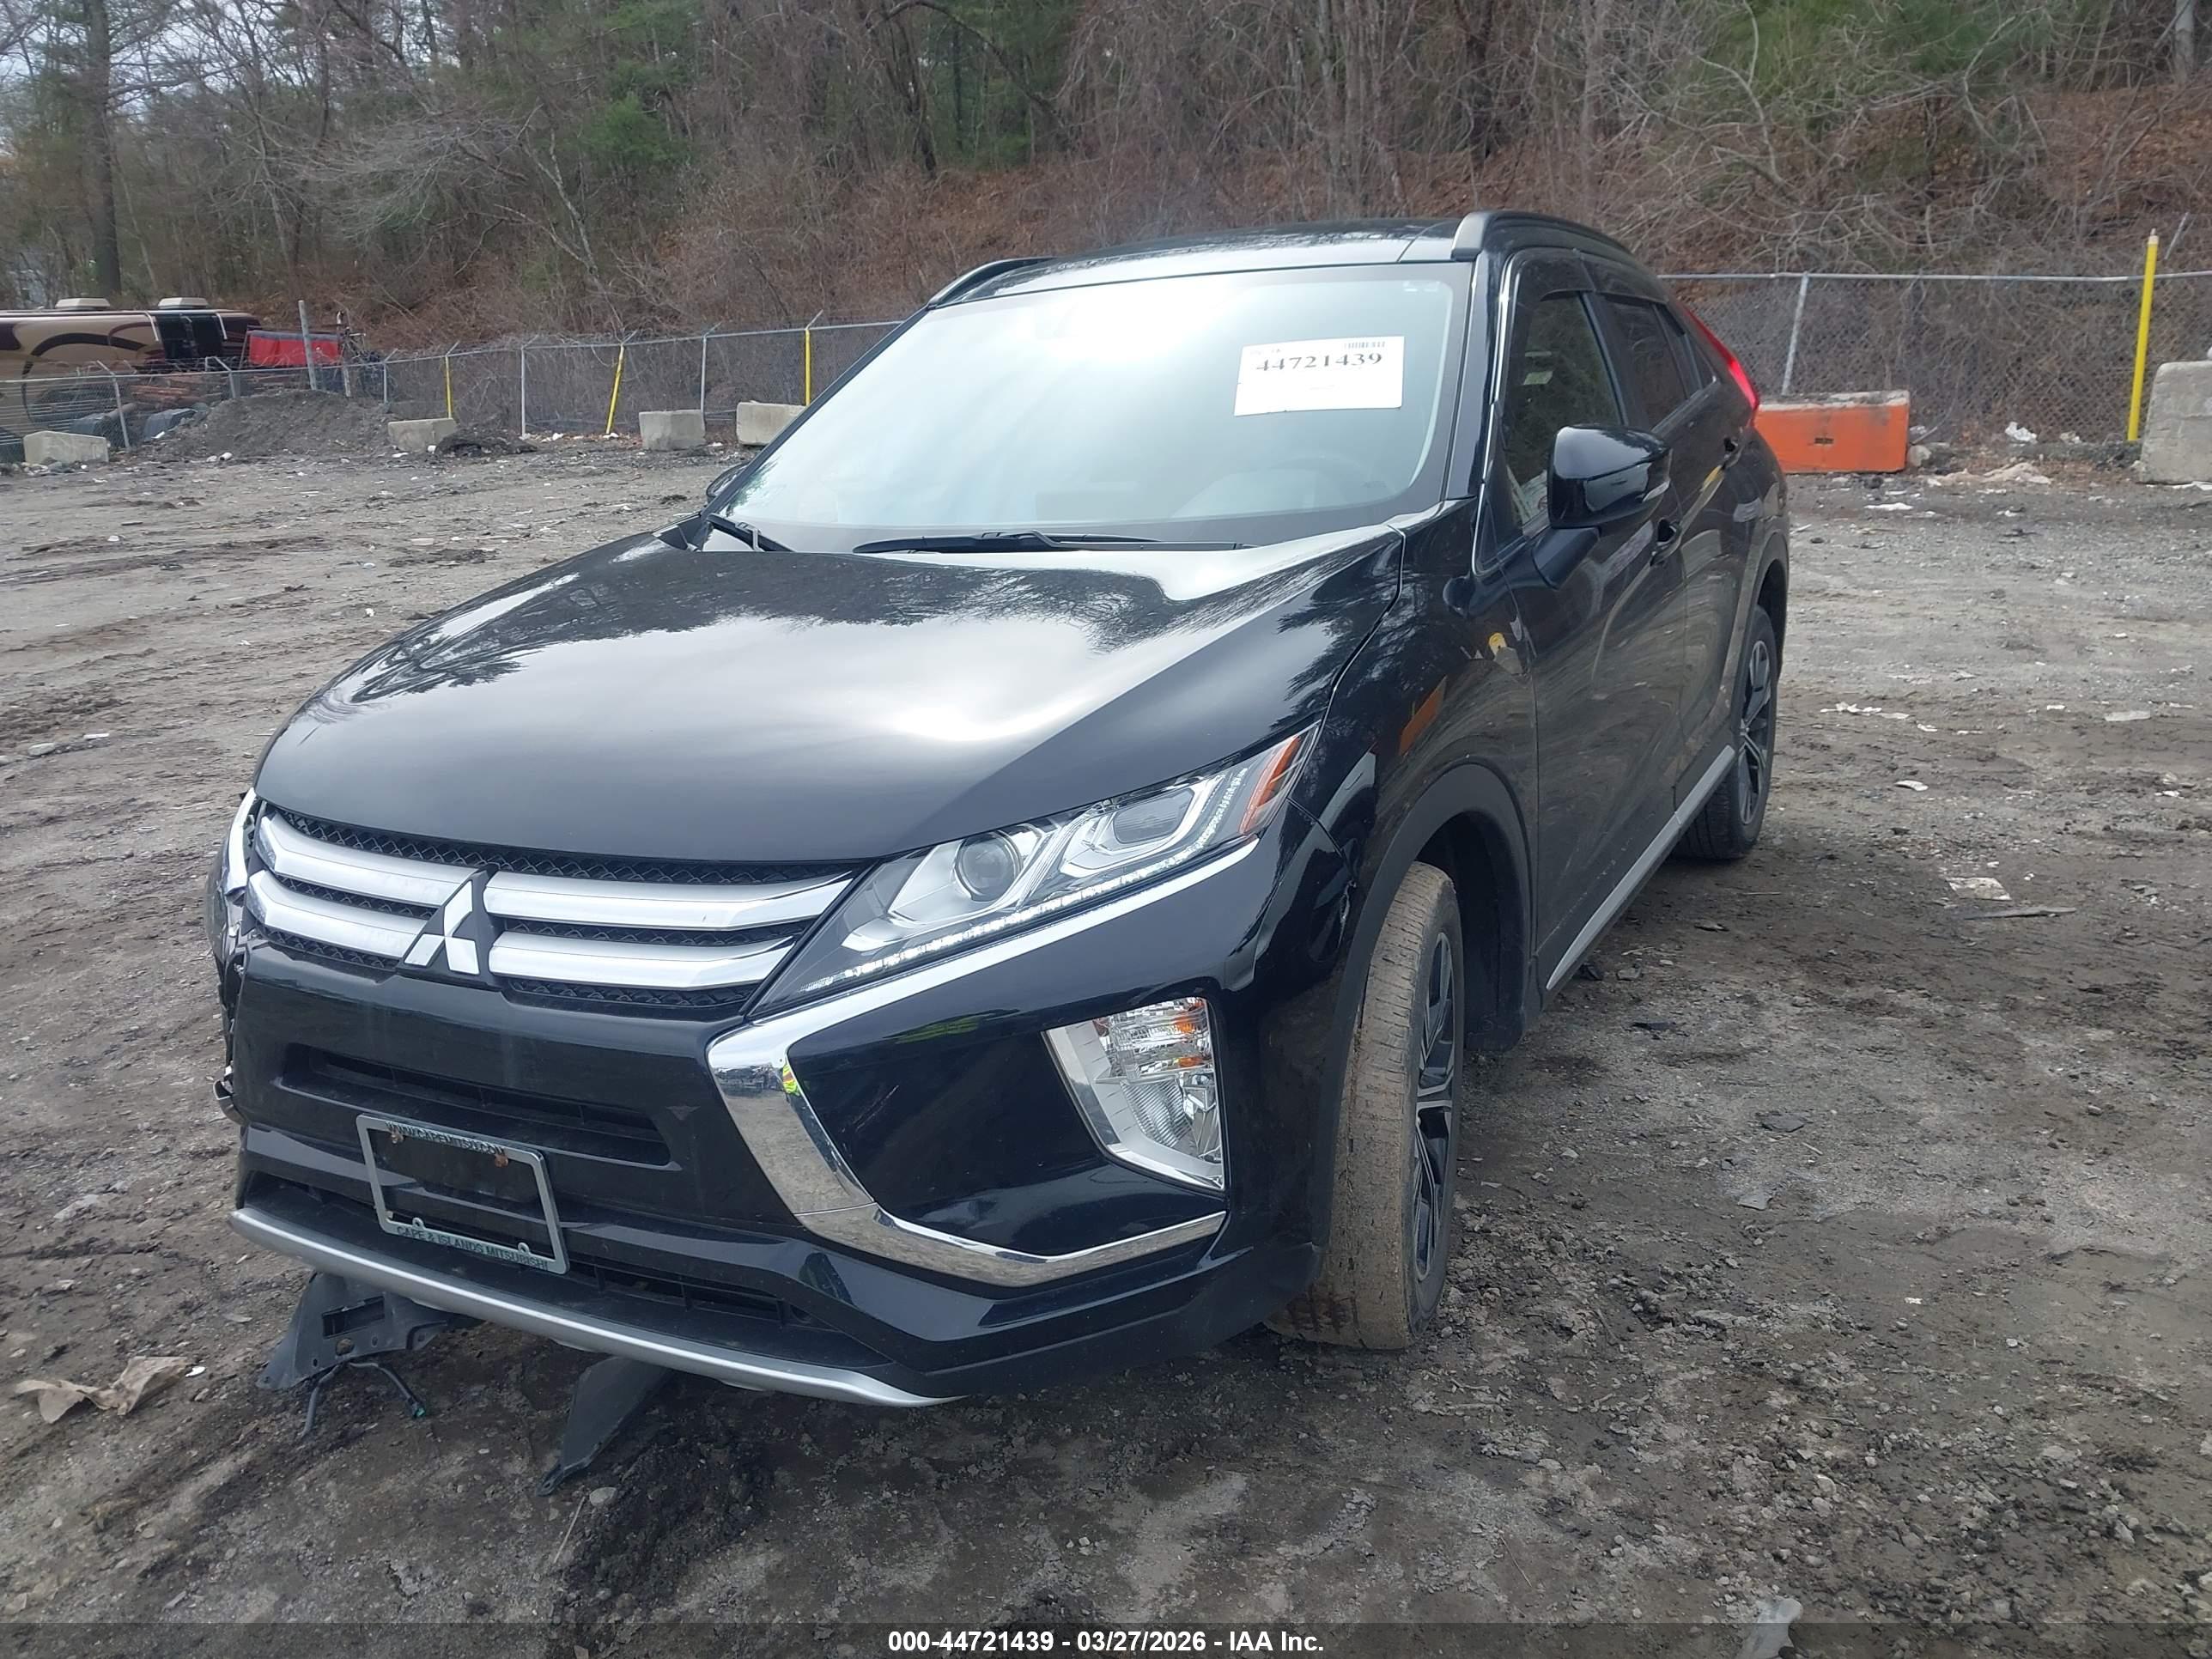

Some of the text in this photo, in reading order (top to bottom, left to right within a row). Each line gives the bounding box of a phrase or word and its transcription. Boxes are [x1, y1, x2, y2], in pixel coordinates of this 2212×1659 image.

[1256, 353, 1382, 371] 44721439
[396, 1225, 426, 1240] CAPE
[438, 1236, 483, 1254] ISLANDS
[486, 1248, 549, 1271] MITSUBISHI
